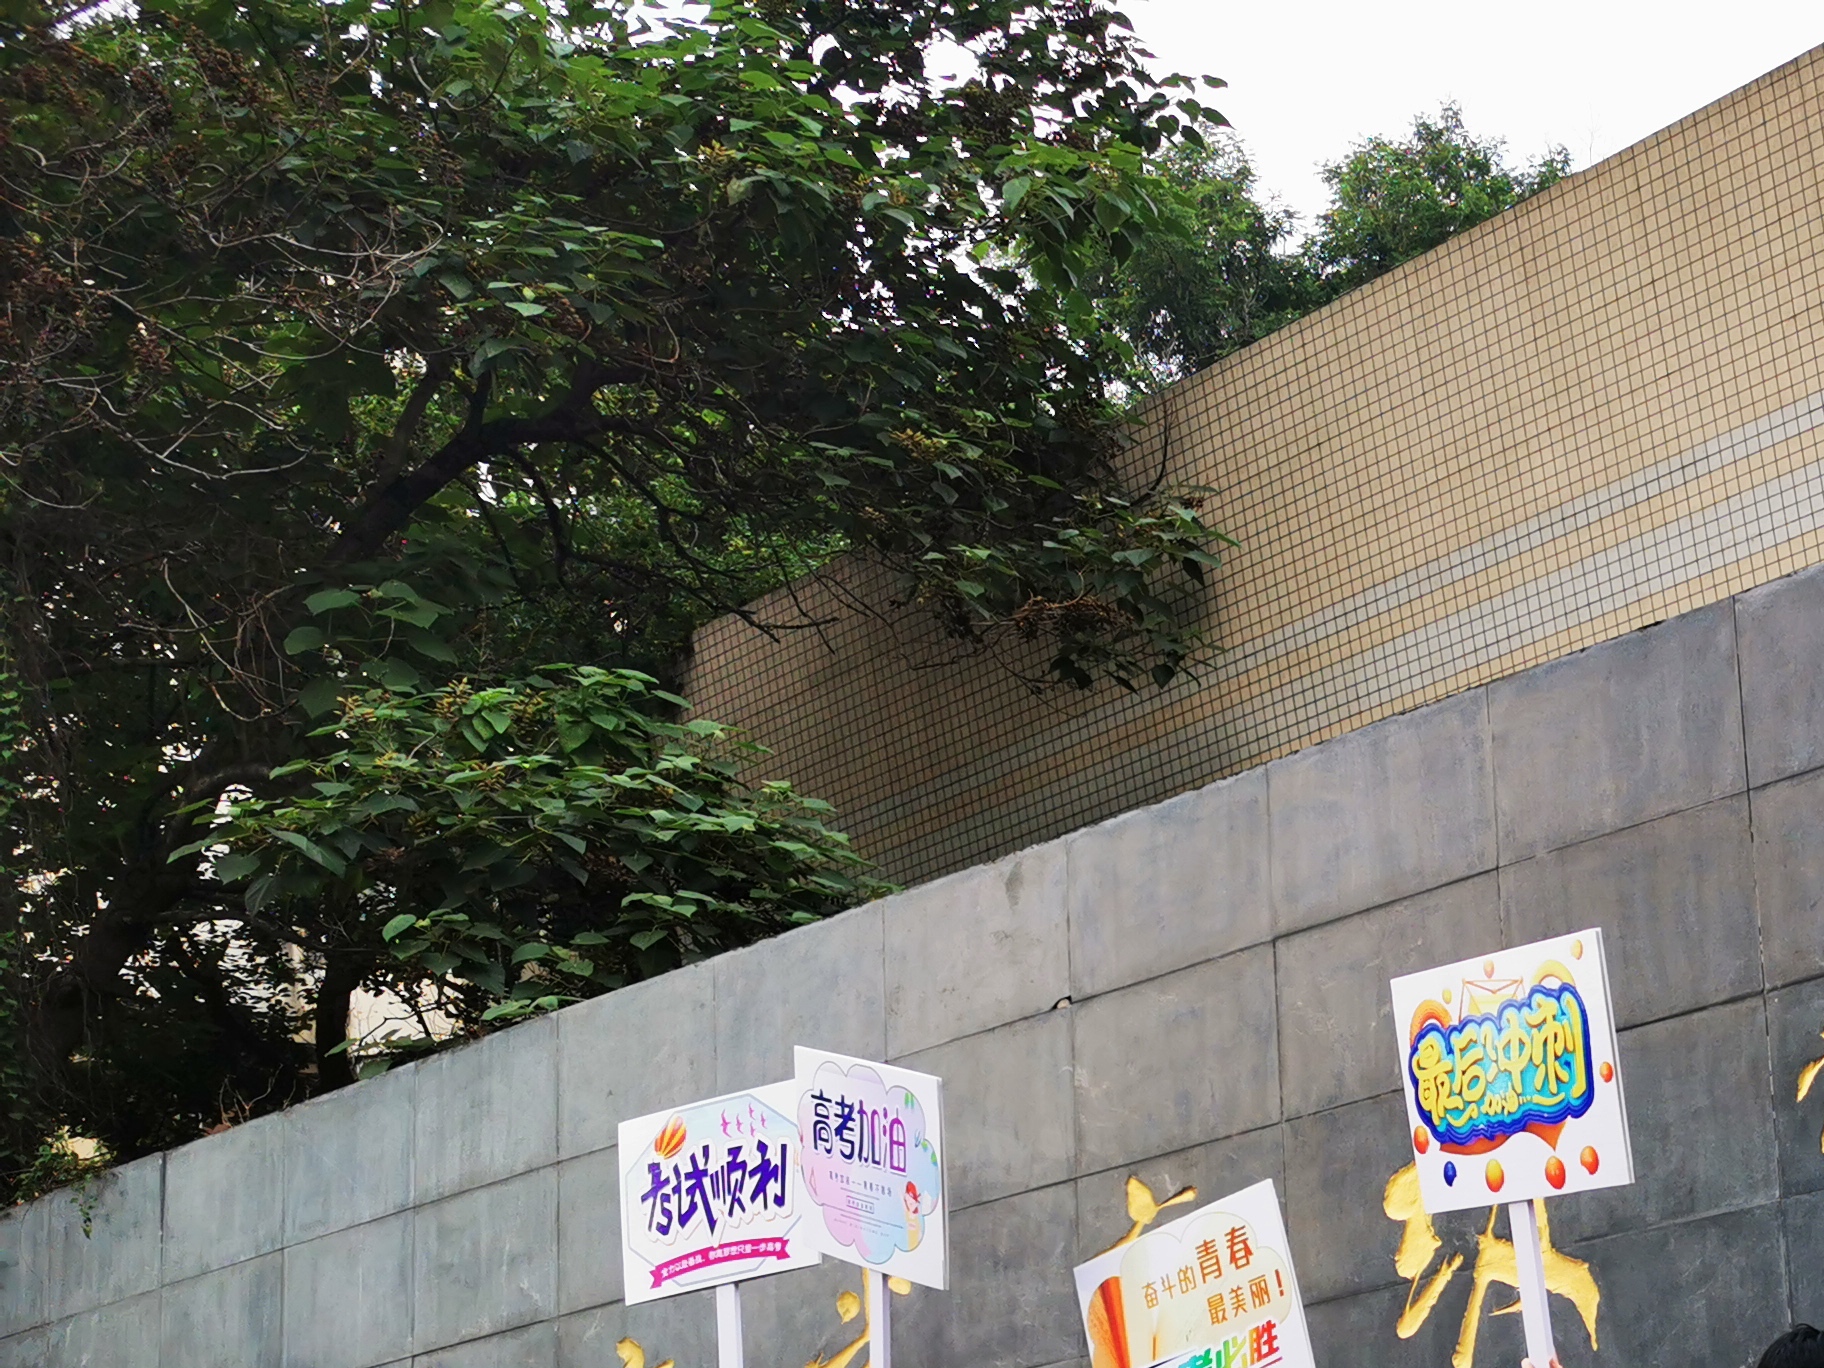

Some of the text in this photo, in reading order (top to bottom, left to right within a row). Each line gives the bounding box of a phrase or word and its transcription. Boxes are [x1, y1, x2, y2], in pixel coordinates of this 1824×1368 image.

[1412, 997, 1588, 1126] 最后冲刺
[811, 1089, 907, 1175] 高考加油
[641, 1140, 788, 1236] 考试顺利
[1142, 1225, 1253, 1309] 奋斗的青春
